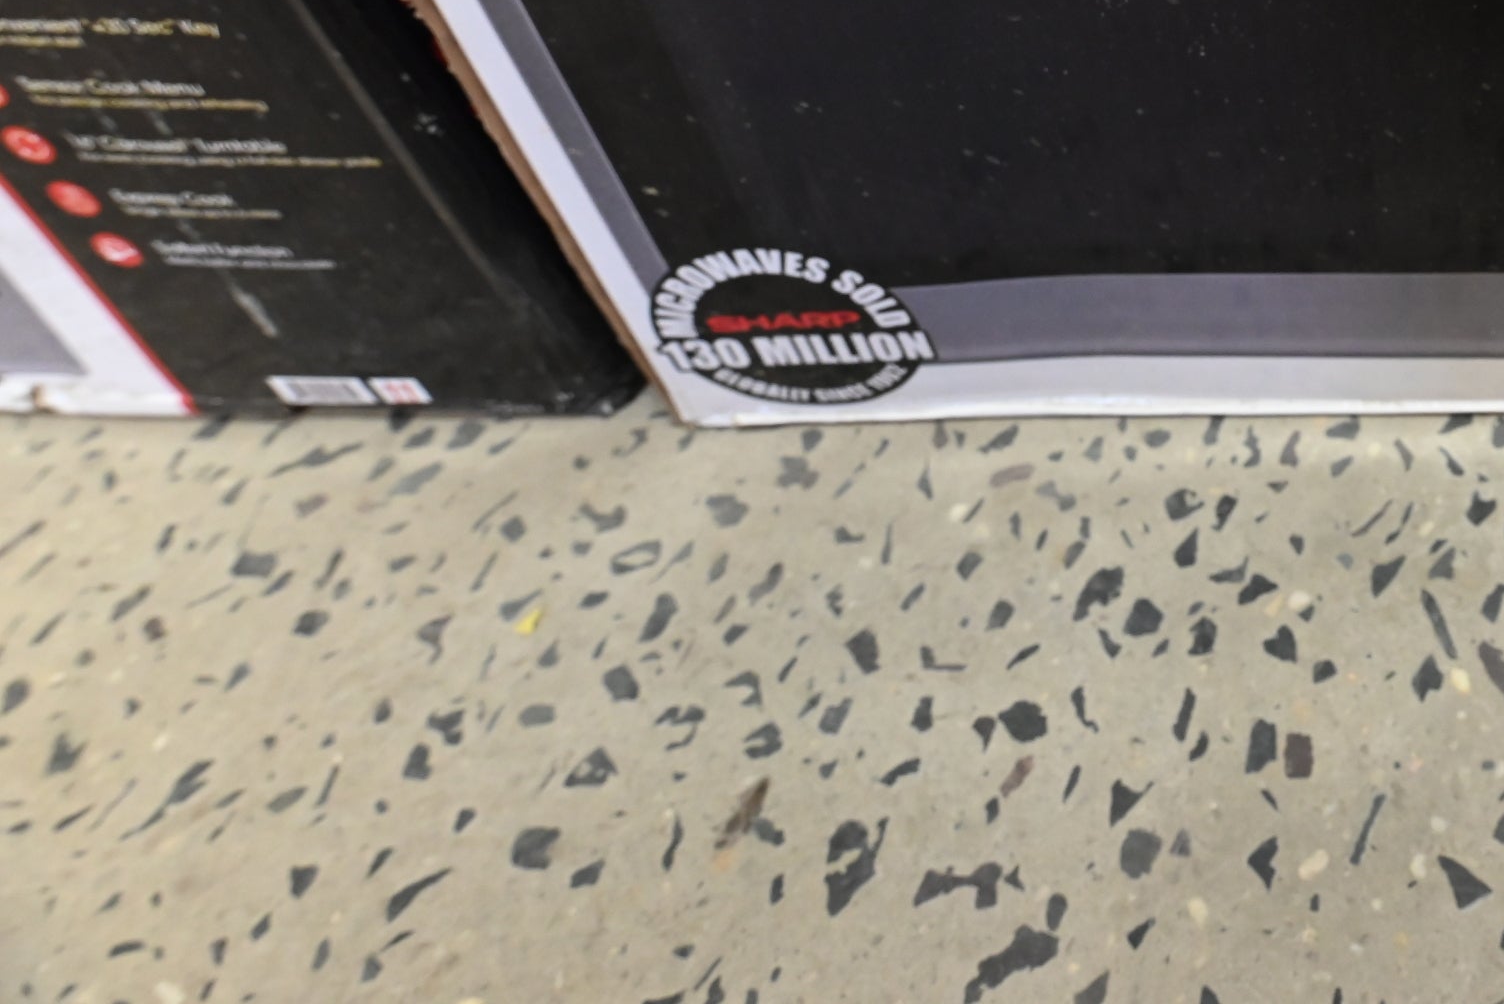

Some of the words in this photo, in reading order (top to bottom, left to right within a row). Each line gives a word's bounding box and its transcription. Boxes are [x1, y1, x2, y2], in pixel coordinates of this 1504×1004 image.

[654, 248, 830, 339] MICROWAVES
[831, 269, 911, 329] SOLD
[662, 337, 751, 371] 130
[751, 331, 934, 367] MILLION
